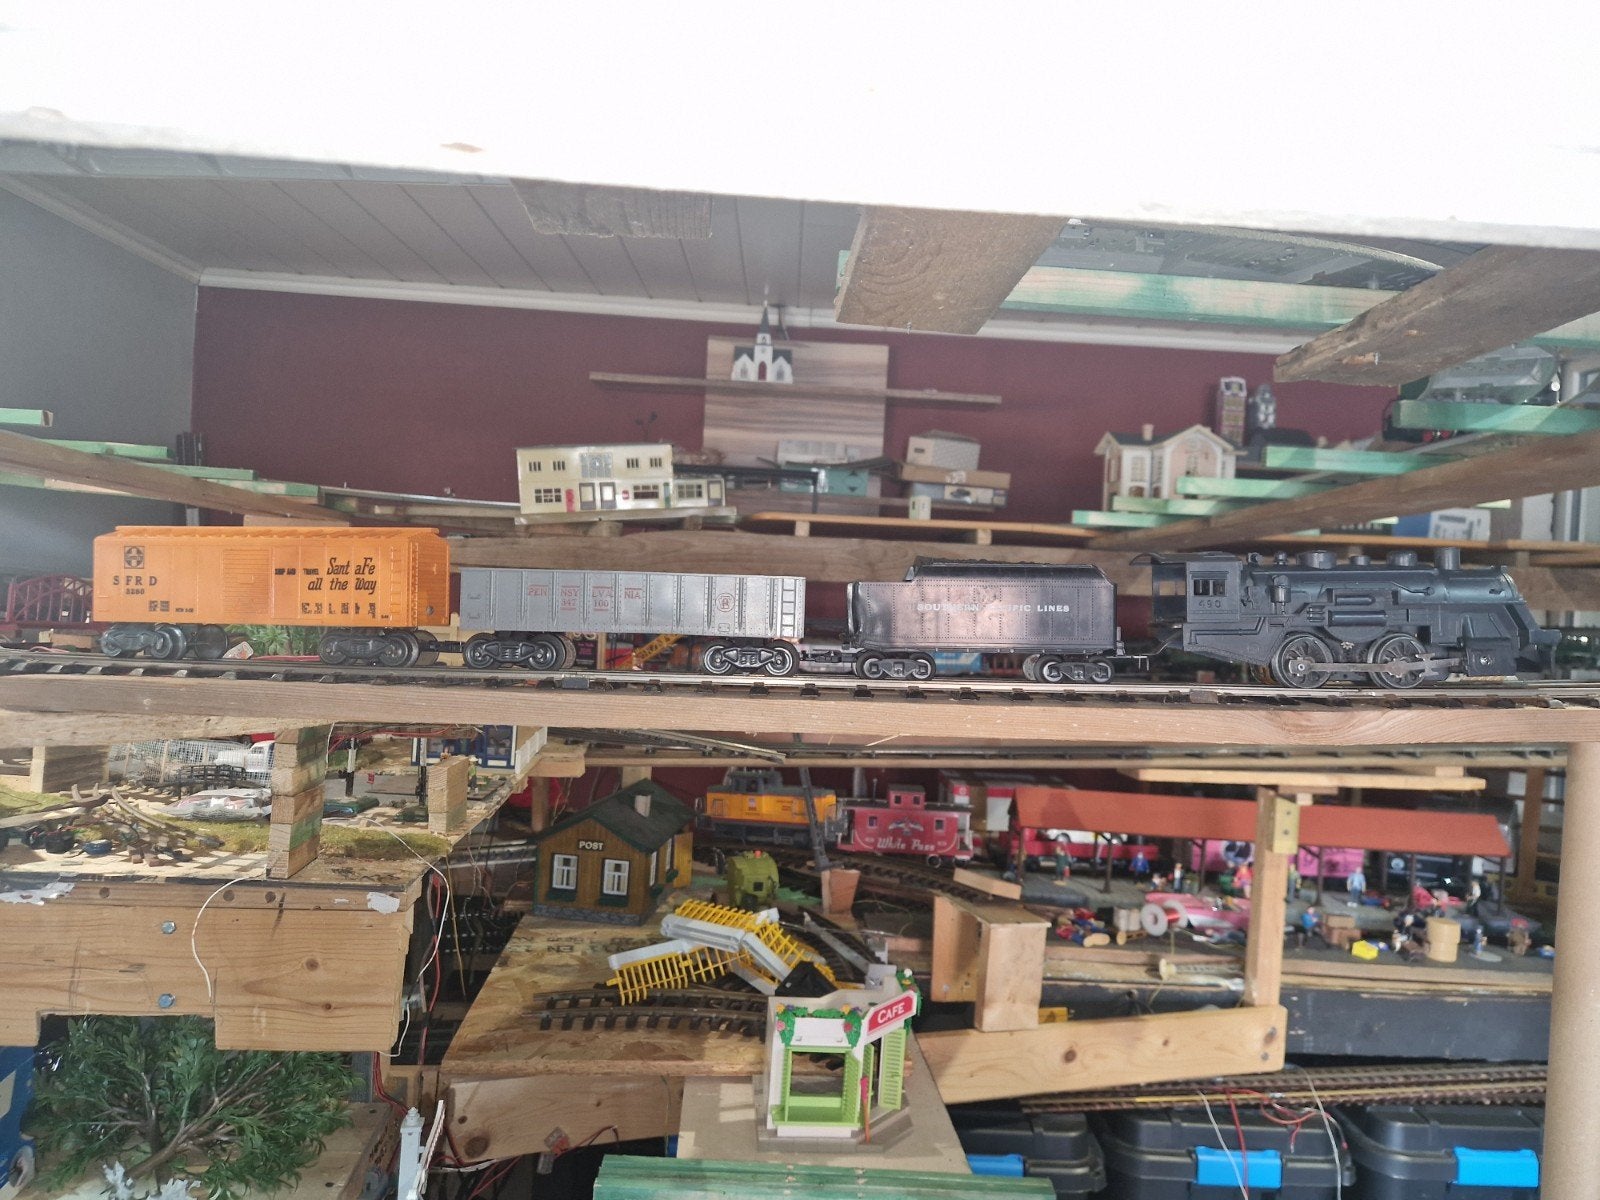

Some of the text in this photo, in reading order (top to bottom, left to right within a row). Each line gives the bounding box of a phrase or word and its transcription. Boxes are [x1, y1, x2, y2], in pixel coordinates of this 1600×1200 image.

[307, 578, 377, 595] all the Way
[917, 603, 980, 612] SOUERN
[1037, 604, 1070, 612] LINES
[578, 840, 604, 850] POST
[877, 837, 906, 850] White
[877, 1002, 905, 1024] CAFE
